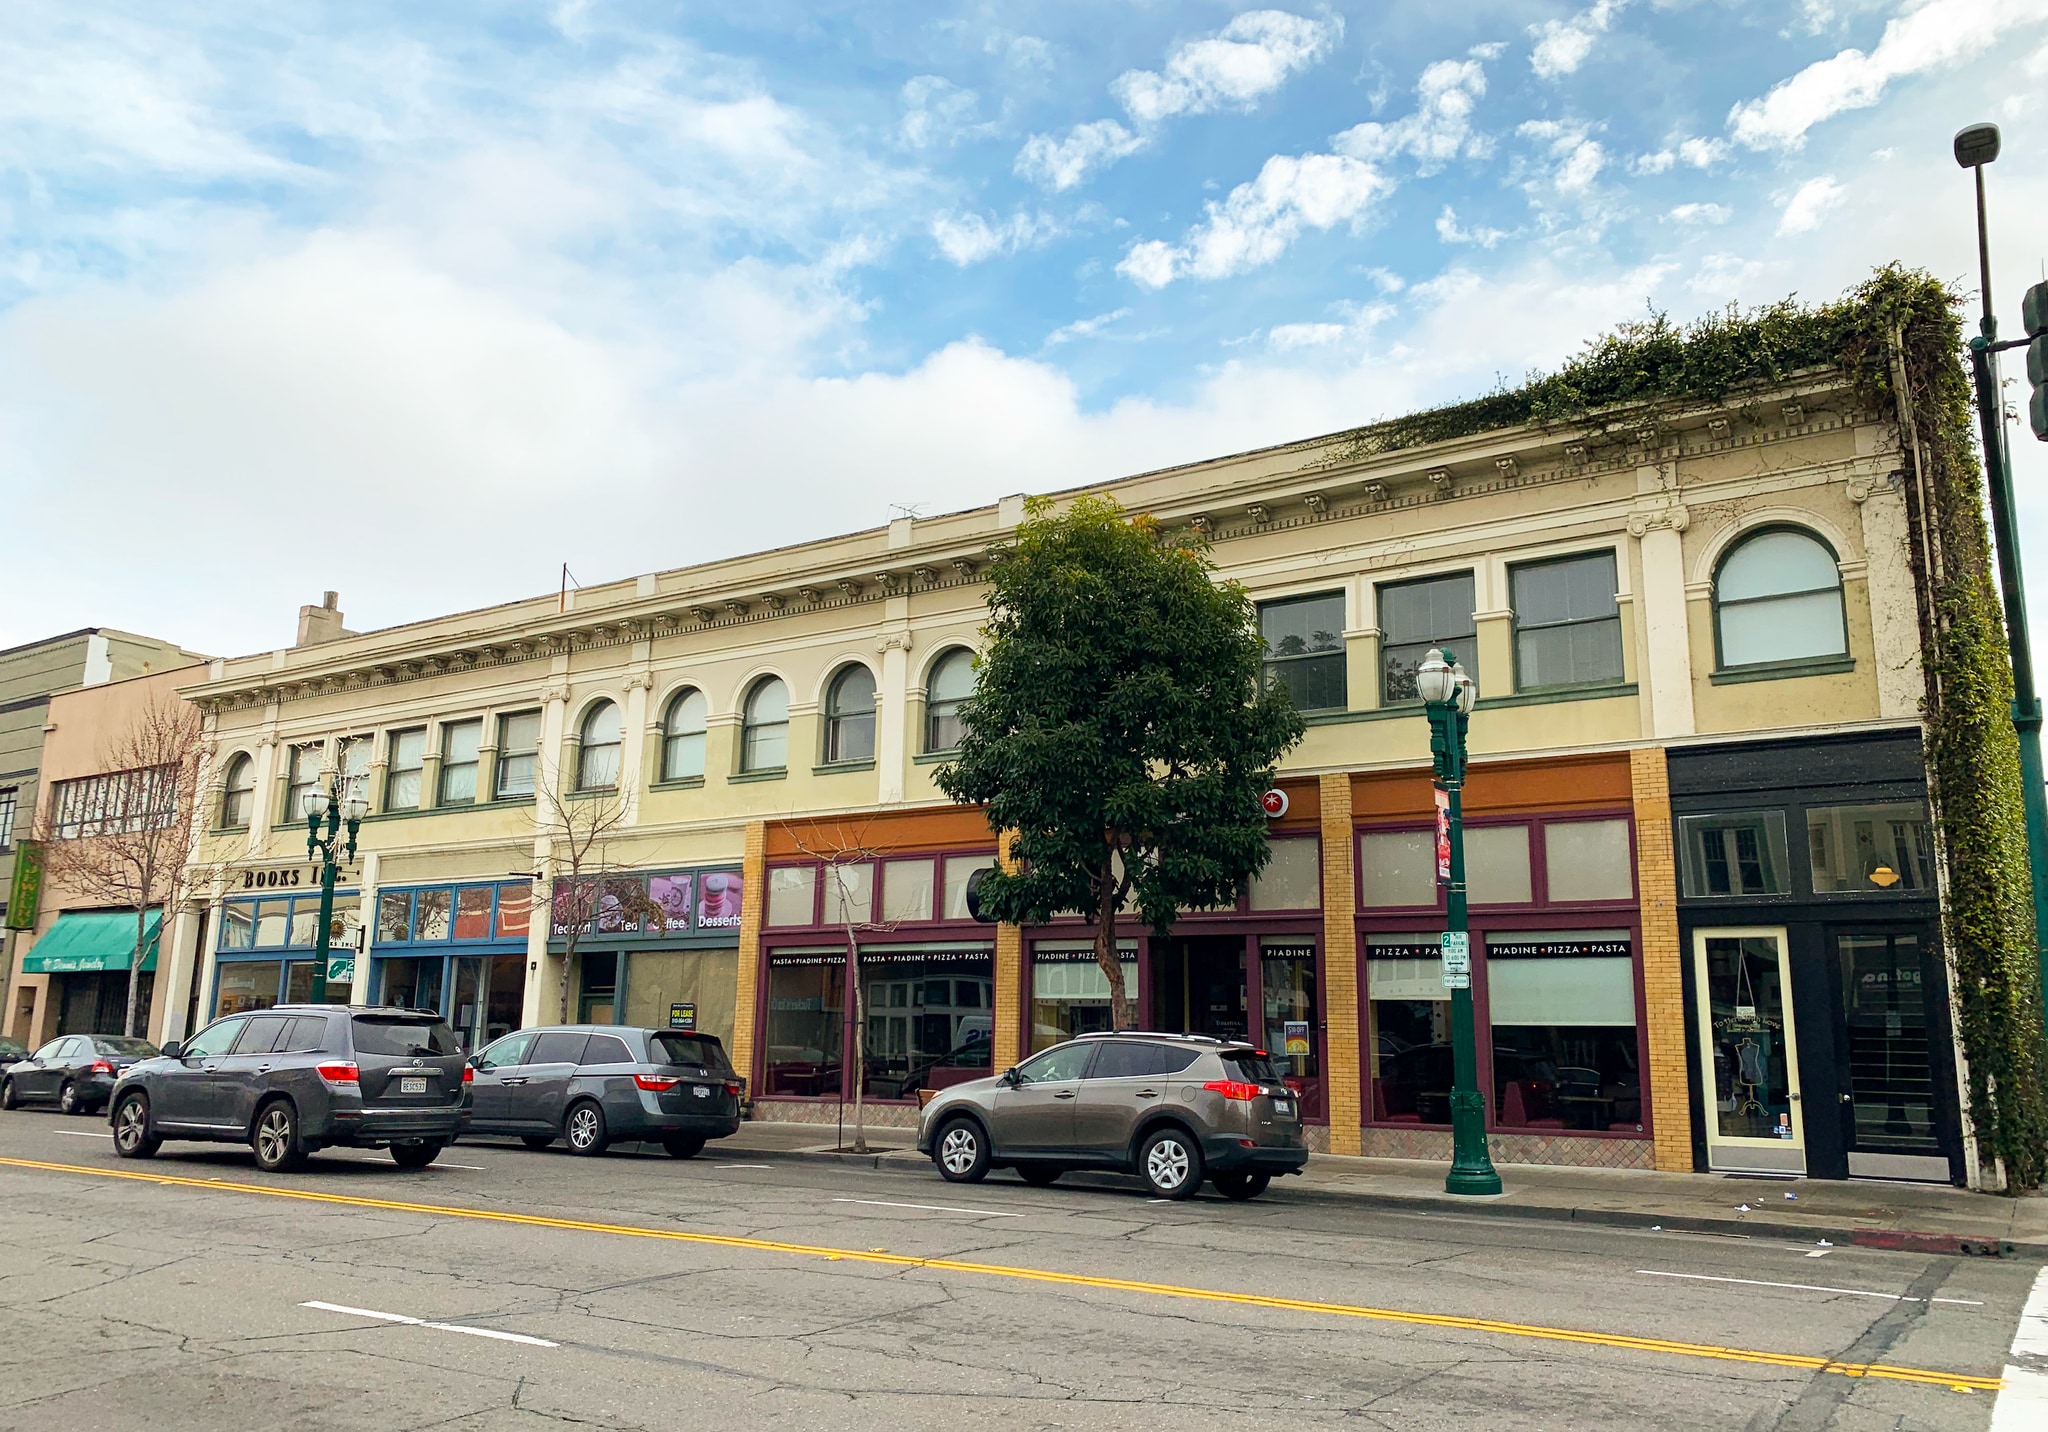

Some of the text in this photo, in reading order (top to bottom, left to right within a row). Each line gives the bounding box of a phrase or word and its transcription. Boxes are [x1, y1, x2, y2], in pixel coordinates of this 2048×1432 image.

[243, 869, 299, 888] BOOKS
[620, 920, 638, 931] Tea
[652, 917, 685, 930] Cffee
[698, 914, 741, 928] Desserts
[1443, 935, 1450, 946] 2
[1267, 949, 1311, 957] PIADINE
[1375, 948, 1409, 956] PIZZA
[1493, 944, 1626, 955] PIADINE PIZZA PASTA
[348, 960, 355, 970] 2
[671, 1009, 694, 1018] FOR LEASE
